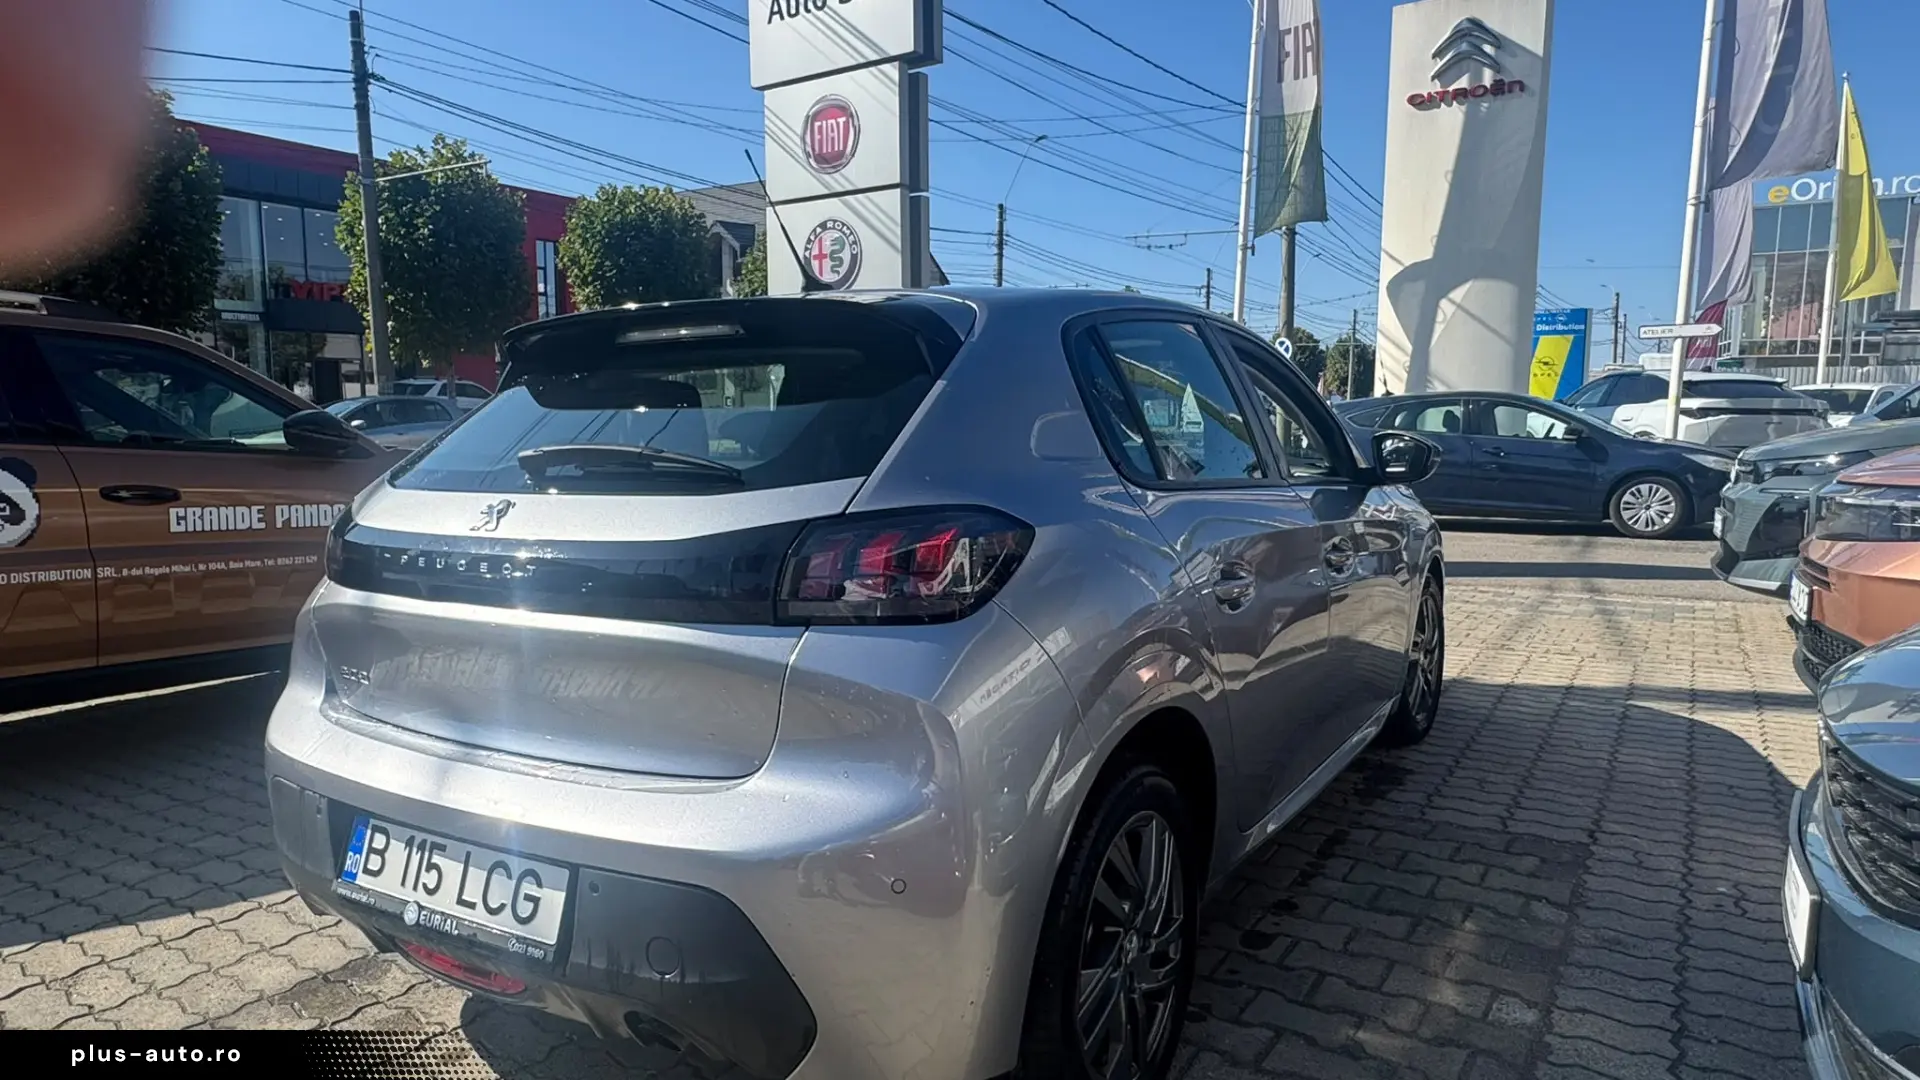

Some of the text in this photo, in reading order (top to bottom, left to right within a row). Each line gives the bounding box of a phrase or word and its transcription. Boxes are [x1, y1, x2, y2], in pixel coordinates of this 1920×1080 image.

[1277, 20, 1319, 84] FIA
[814, 117, 846, 155] FIAT
[804, 221, 858, 258] ALFA ROMEO
[1536, 323, 1585, 331] Distribution
[1642, 328, 1674, 336] ATELIER
[169, 505, 267, 533] GRANDE
[10, 568, 92, 584] DISTRIBUTION
[400, 554, 536, 576] PEUGEOT
[344, 851, 360, 874] RO
[362, 824, 543, 925] B 115 LCG
